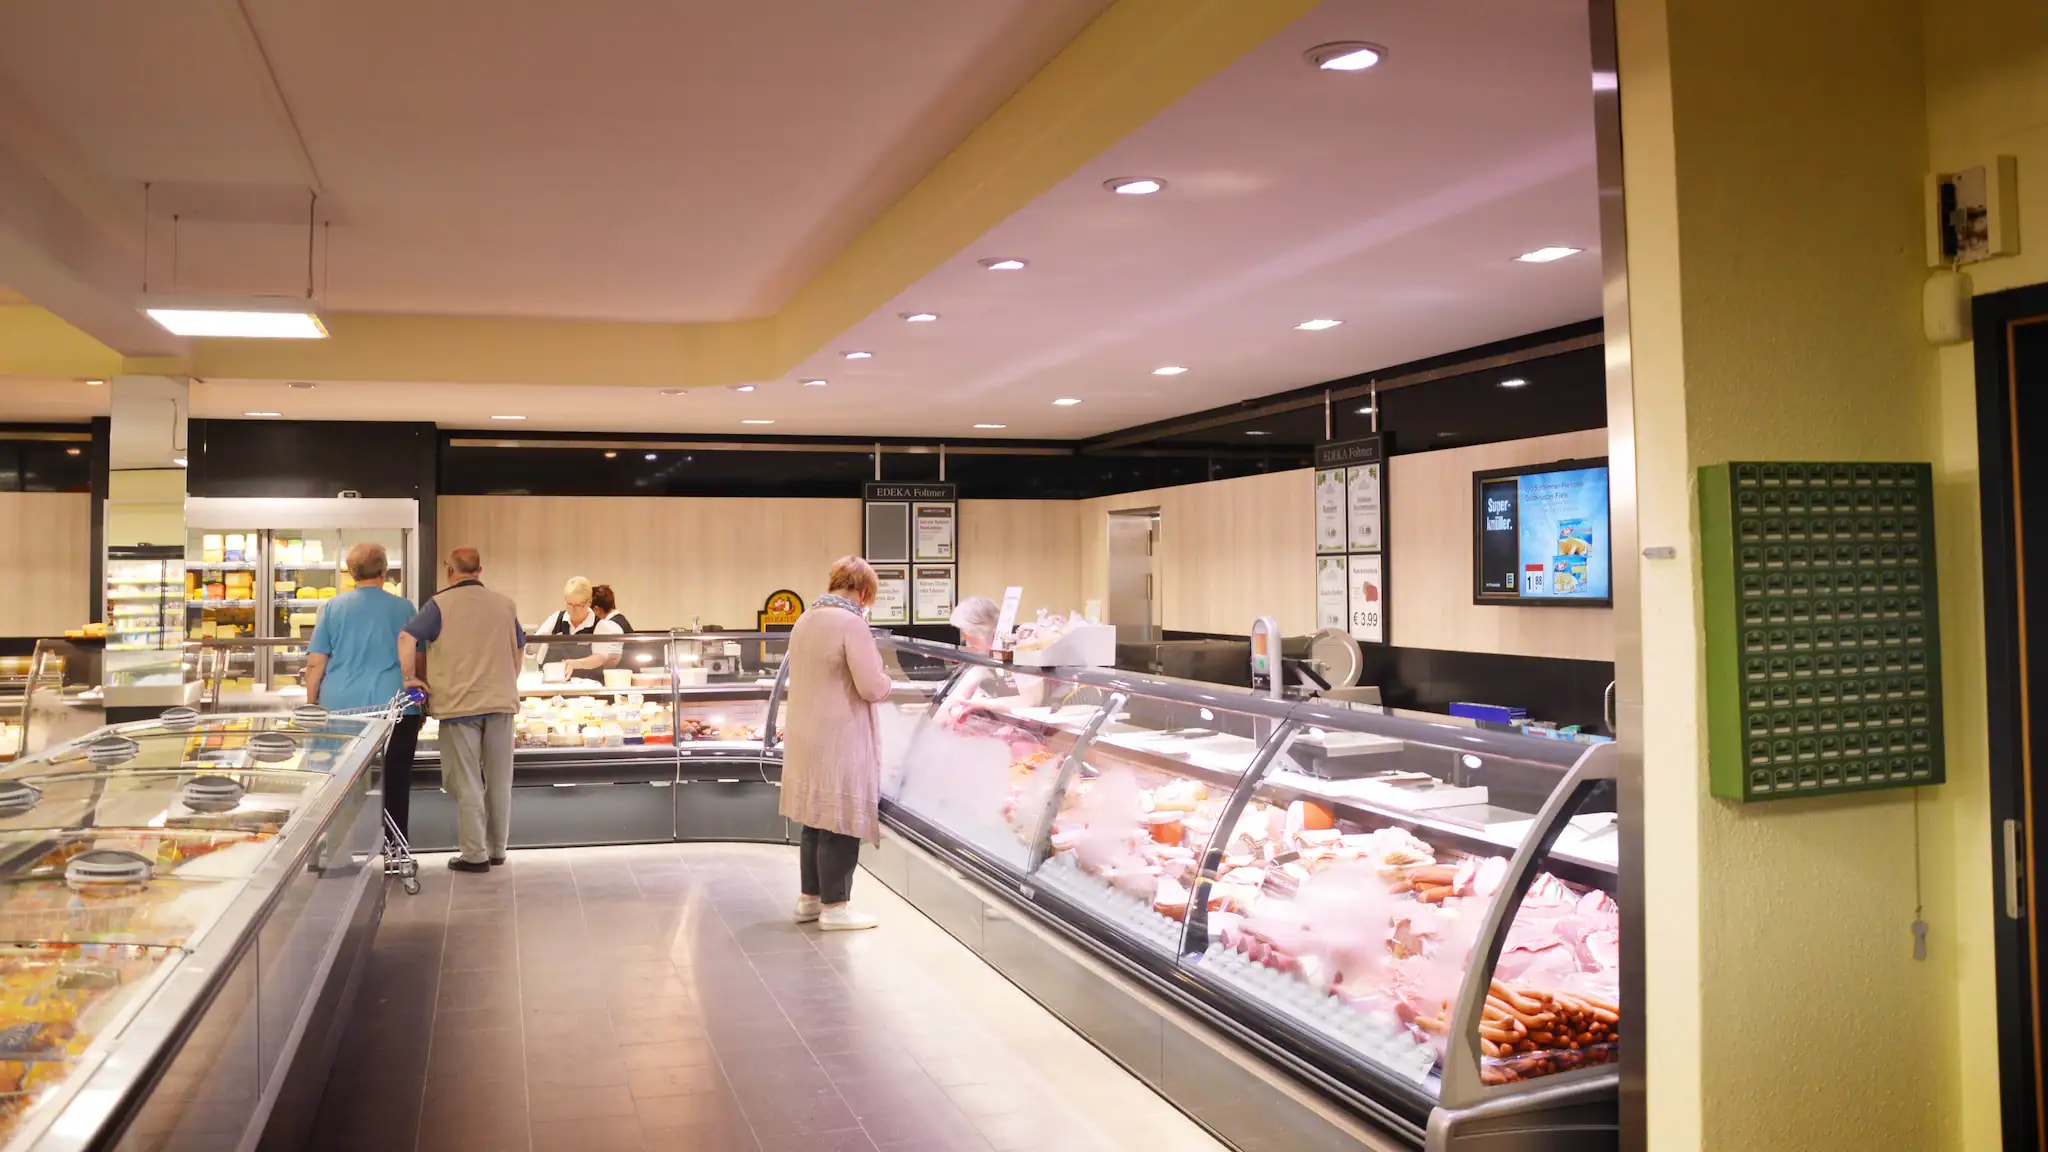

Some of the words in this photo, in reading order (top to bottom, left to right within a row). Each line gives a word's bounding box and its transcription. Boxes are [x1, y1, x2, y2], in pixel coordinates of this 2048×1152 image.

[1323, 448, 1348, 461] EDEKA
[877, 487, 911, 497] EDEKA
[1487, 498, 1511, 515] Super-
[1486, 516, 1513, 531] knüller.
[1353, 612, 1359, 626] €
